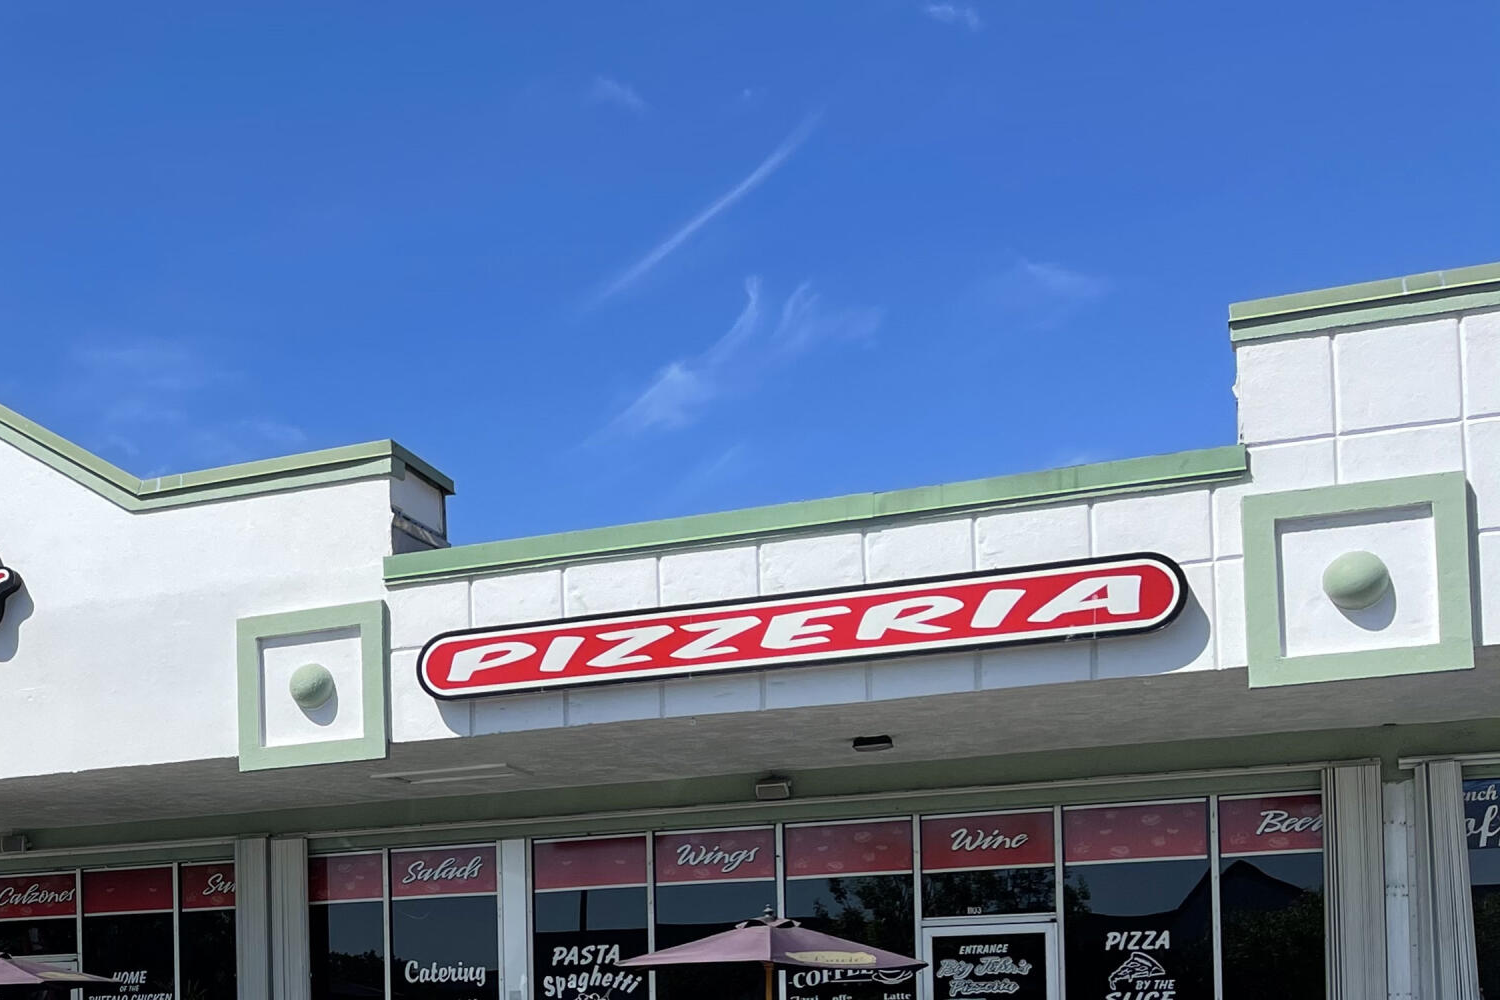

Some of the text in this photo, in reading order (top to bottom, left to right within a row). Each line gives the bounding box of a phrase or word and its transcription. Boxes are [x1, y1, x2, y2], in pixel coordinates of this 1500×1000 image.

[447, 573, 1144, 683] PIZZERIA
[951, 827, 1028, 852] Wine
[676, 843, 760, 873] Wings
[402, 856, 483, 884] Salads
[959, 943, 1009, 955] ENTRANCE
[1105, 930, 1170, 951] PIZZA
[551, 944, 620, 966] PASTA
[113, 970, 147, 984] HOME
[405, 960, 486, 987] Catering
[543, 965, 642, 999] Spaghetti
[792, 969, 874, 989] COFF
[119, 985, 128, 993] OF
[1135, 979, 1175, 990] BY THE
[883, 992, 912, 1000] Latte
